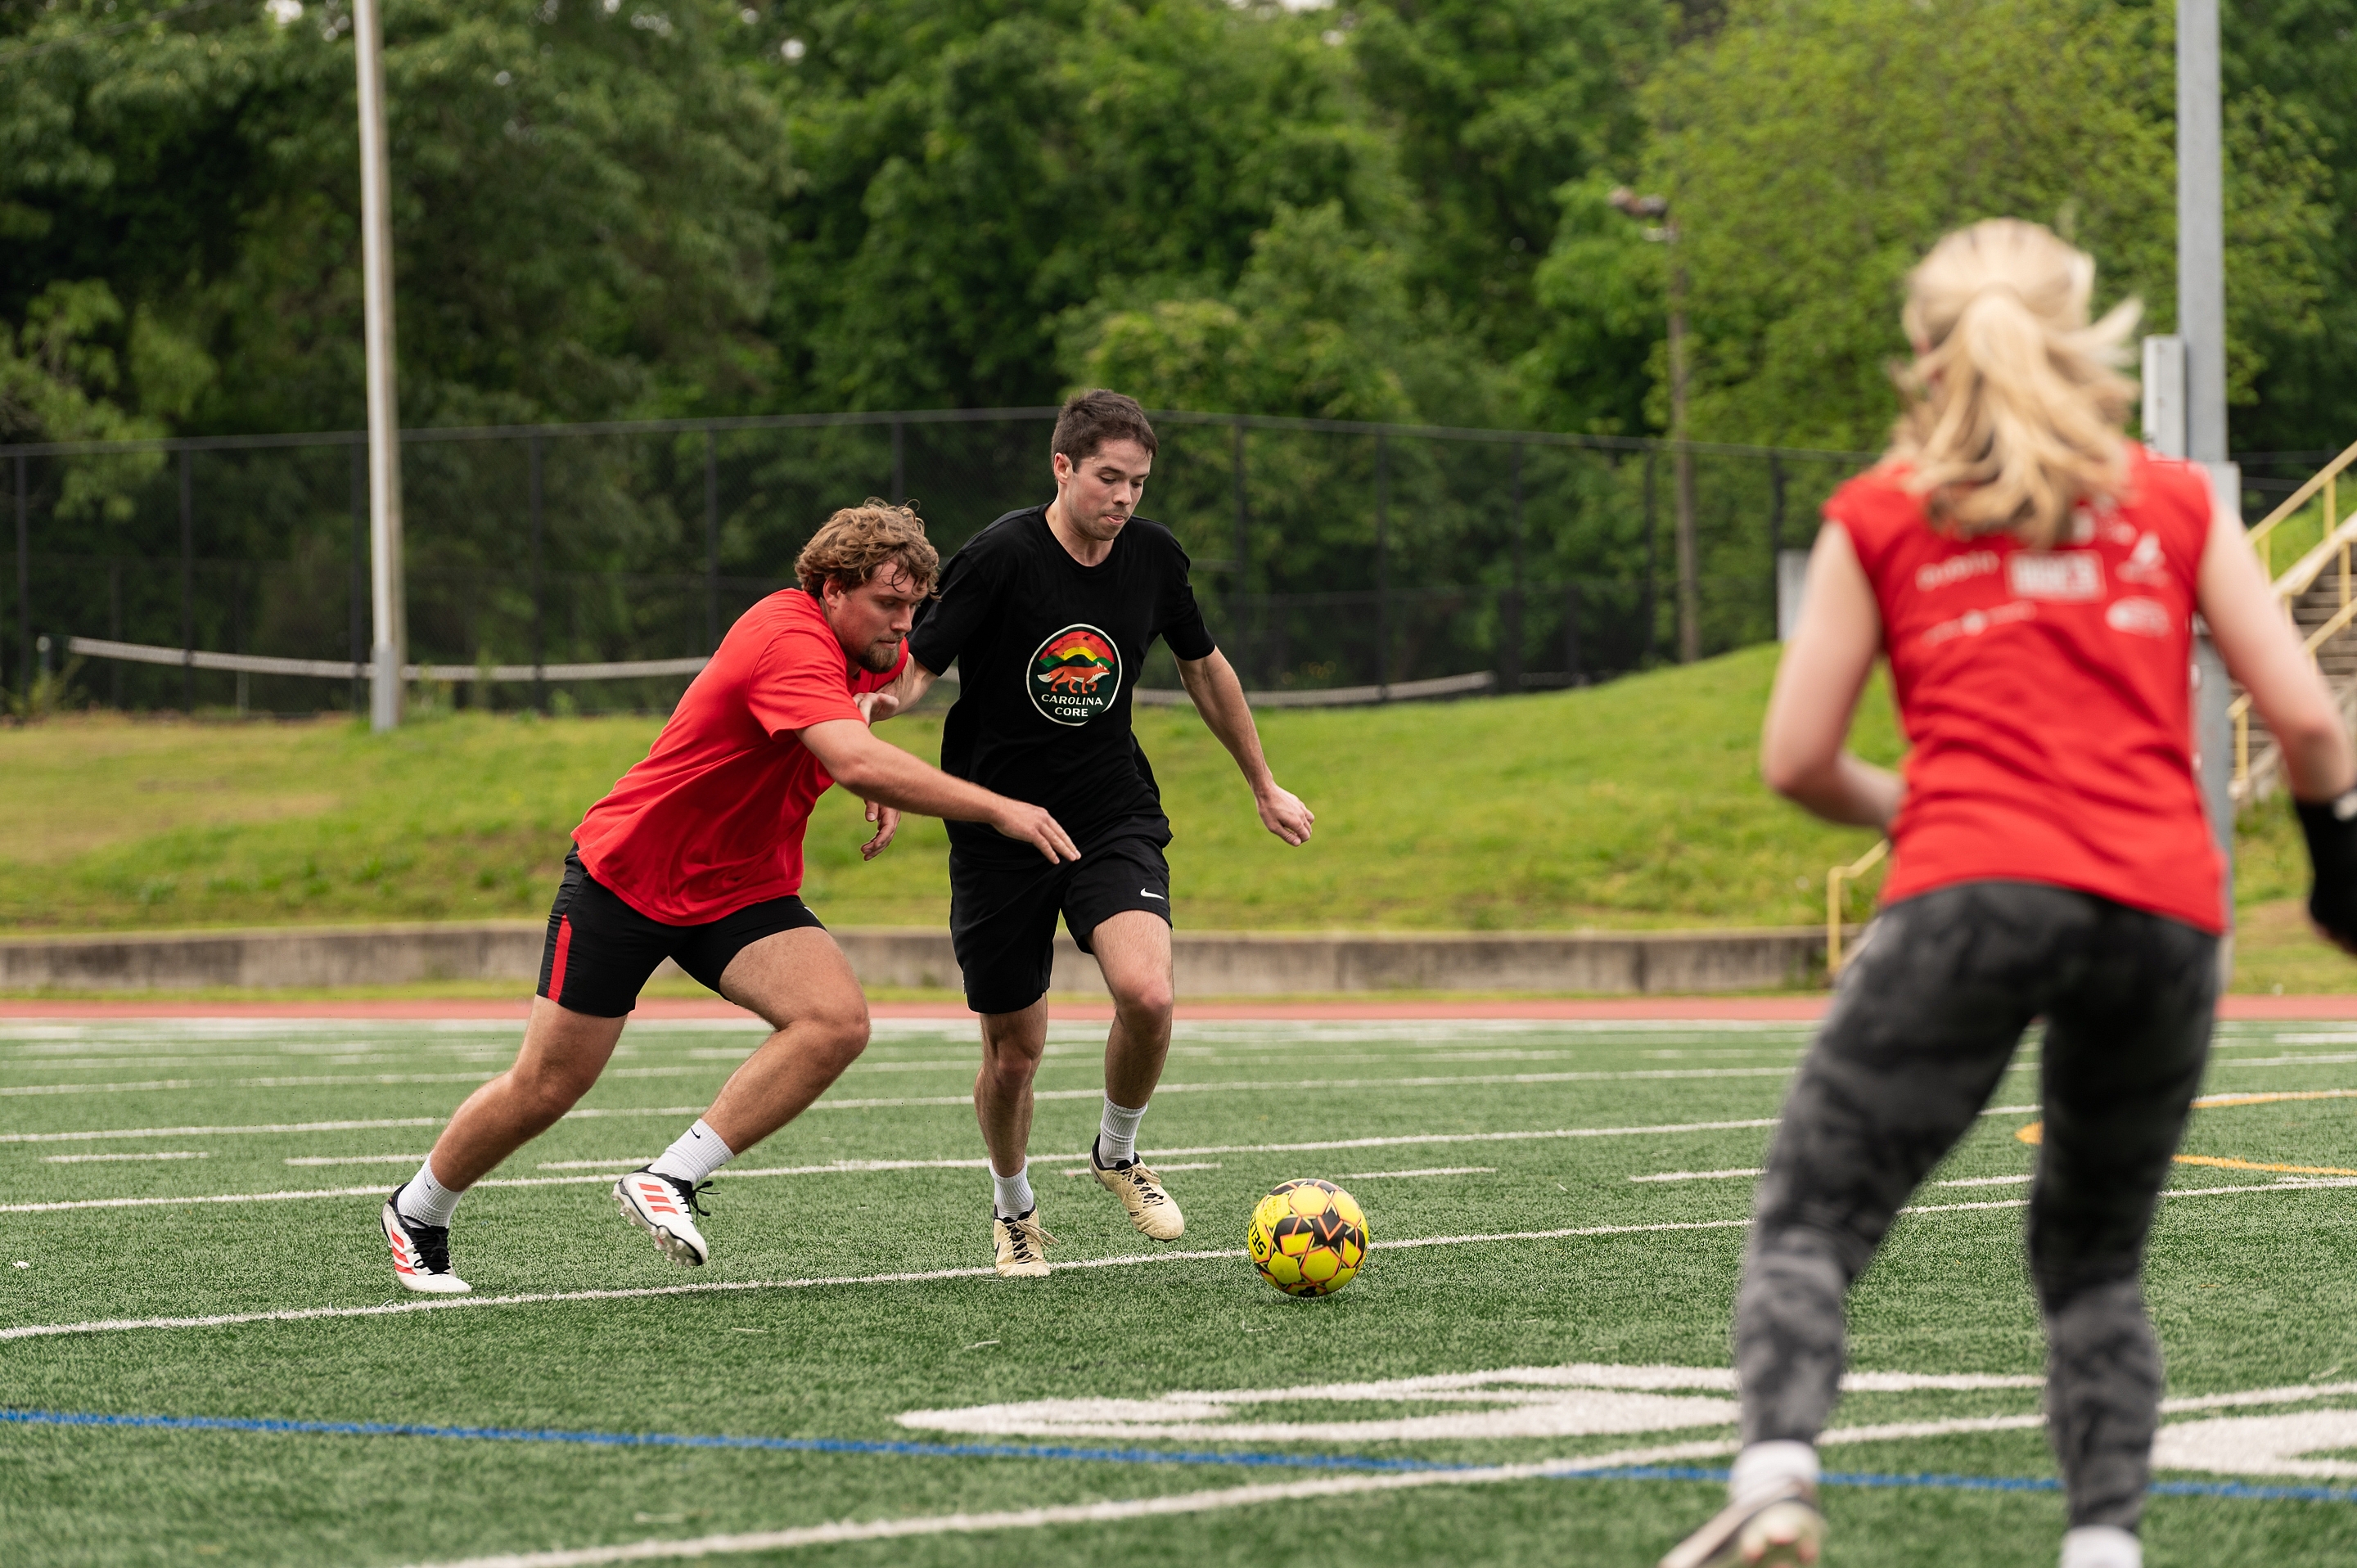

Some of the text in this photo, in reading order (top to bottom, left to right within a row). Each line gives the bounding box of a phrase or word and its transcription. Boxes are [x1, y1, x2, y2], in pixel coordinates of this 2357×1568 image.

[1041, 694, 1103, 705] CAROLINA
[1054, 706, 1088, 717] CORE
[1250, 1208, 1267, 1255] SELE
